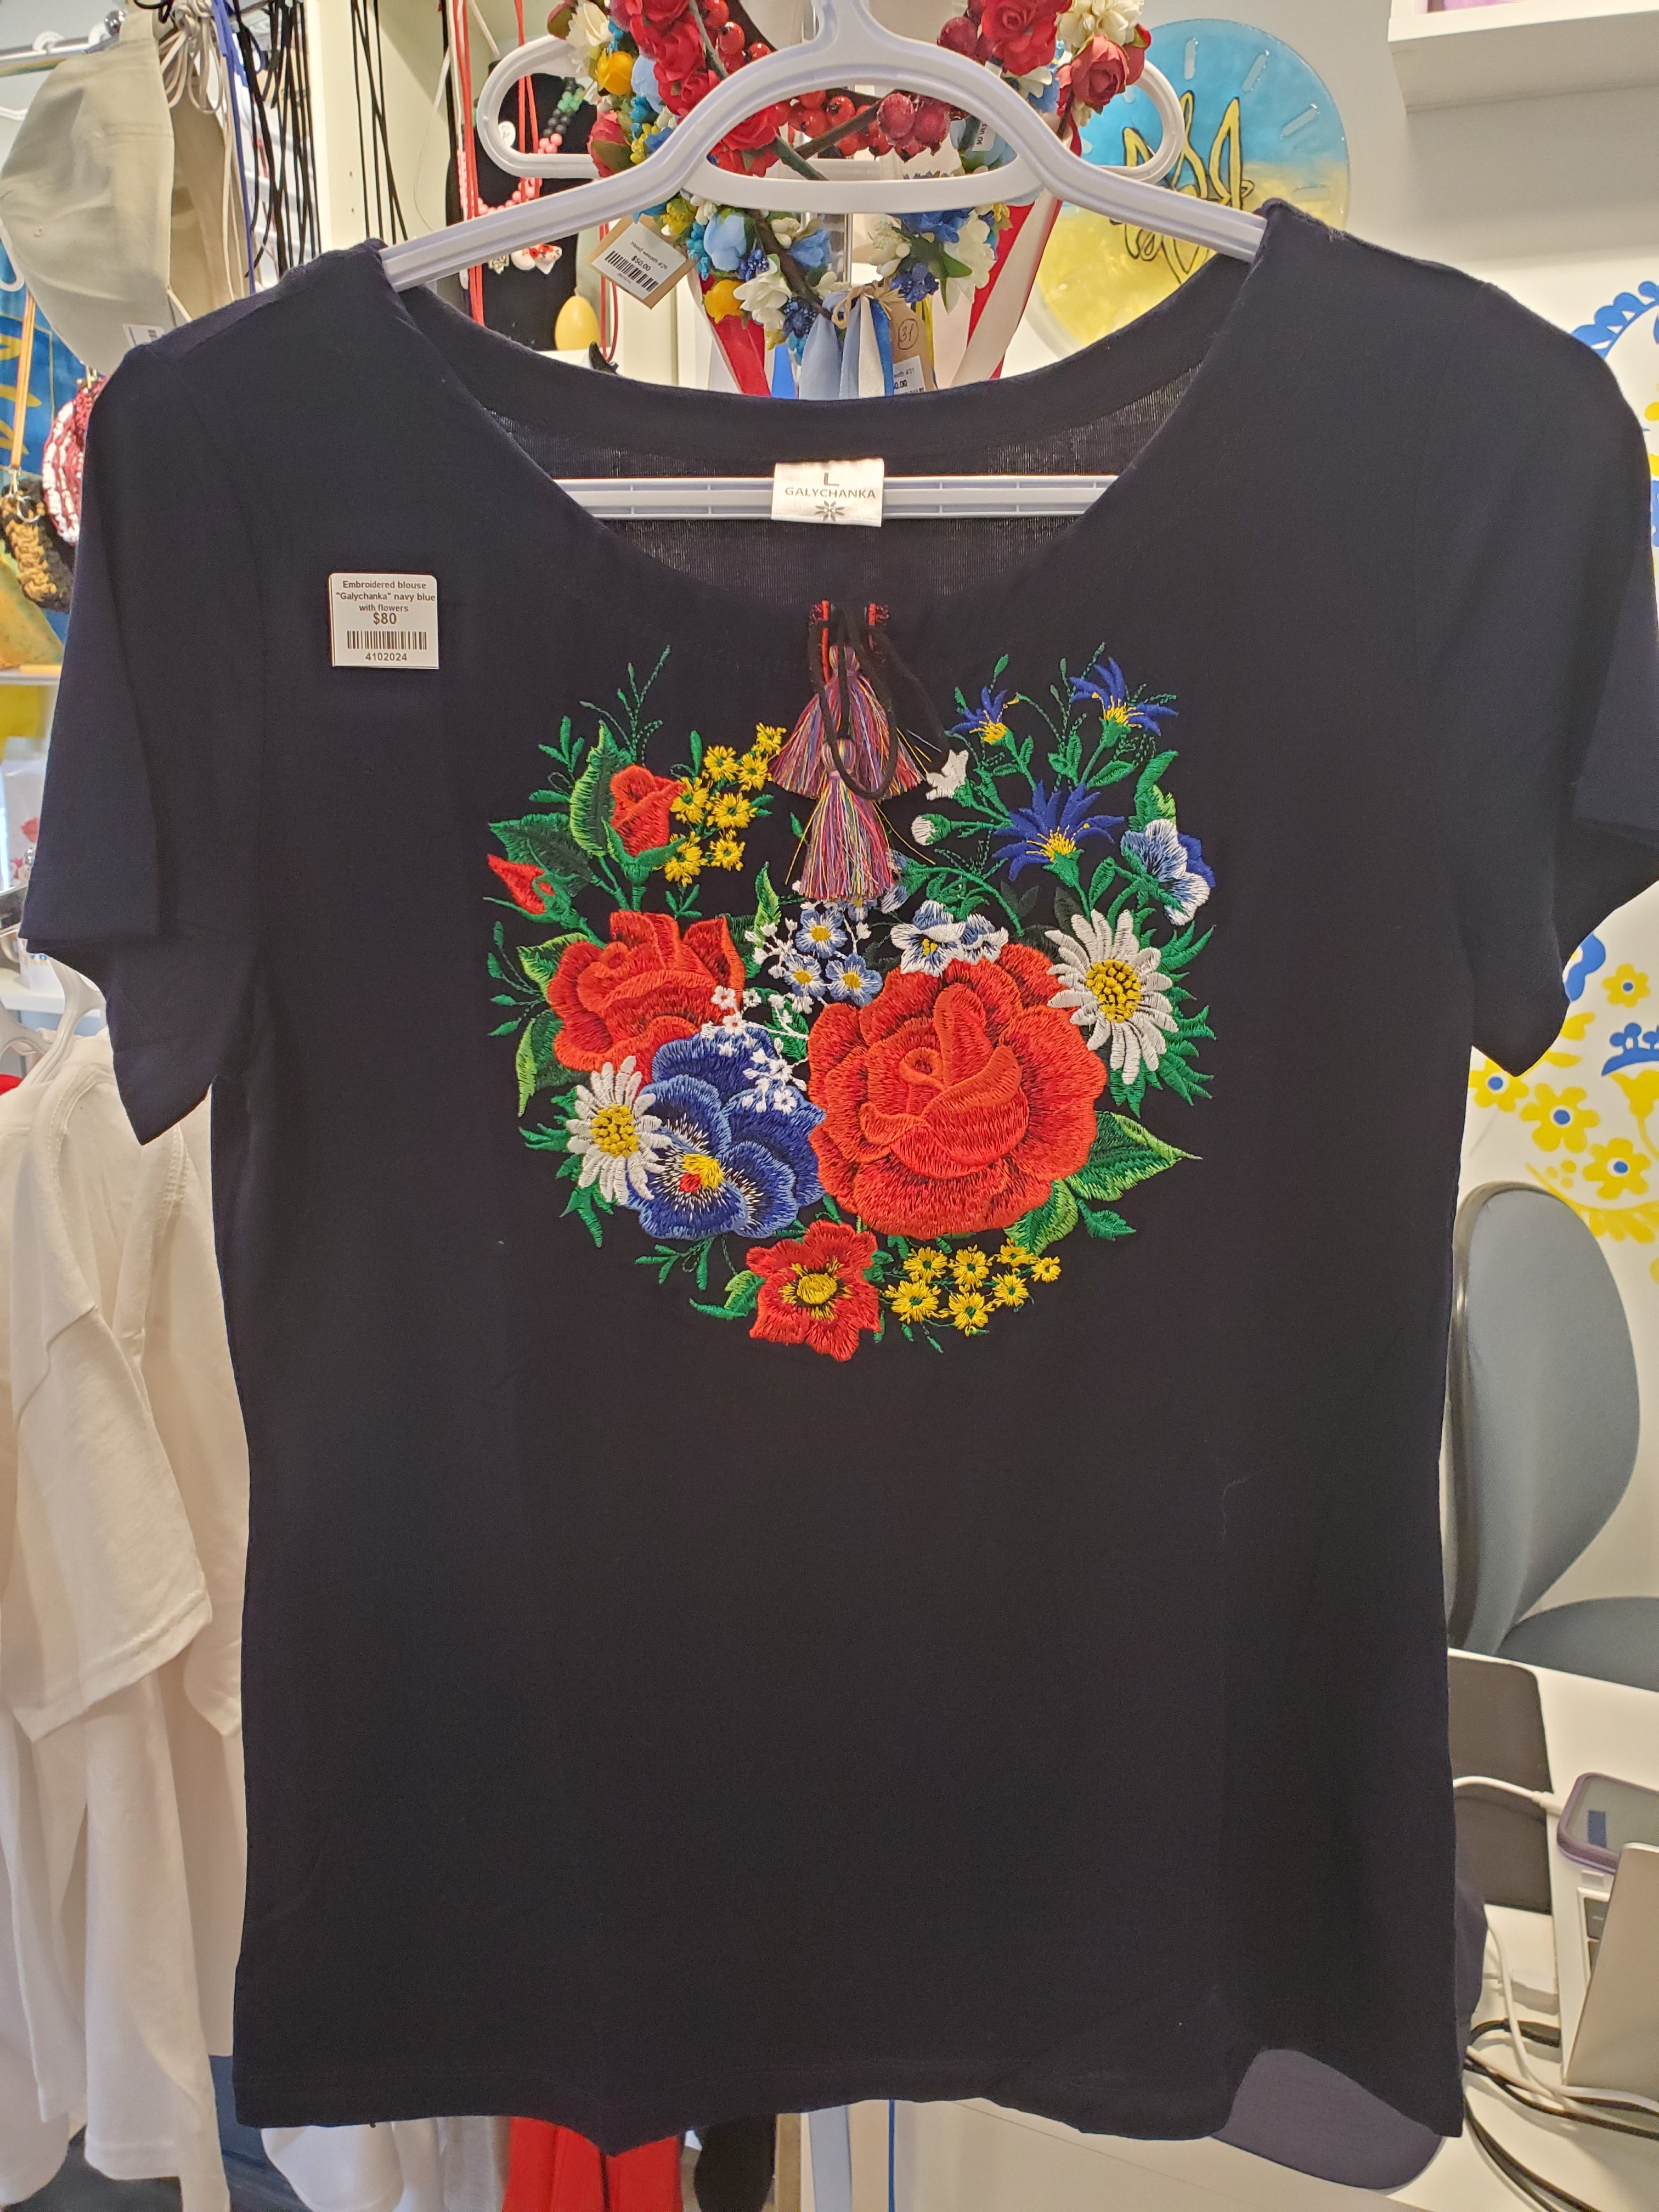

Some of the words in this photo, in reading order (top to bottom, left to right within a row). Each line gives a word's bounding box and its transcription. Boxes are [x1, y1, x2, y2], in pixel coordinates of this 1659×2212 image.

[643, 251, 658, 263] wreath
[631, 256, 651, 271] $50.00
[823, 472, 839, 487] L
[785, 487, 876, 499] GALYCHANKA
[343, 580, 395, 589] Embroidered
[336, 592, 391, 601] "Galychanka"
[417, 593, 435, 601] blue
[373, 612, 397, 625] $80
[365, 652, 407, 661] 4102024
